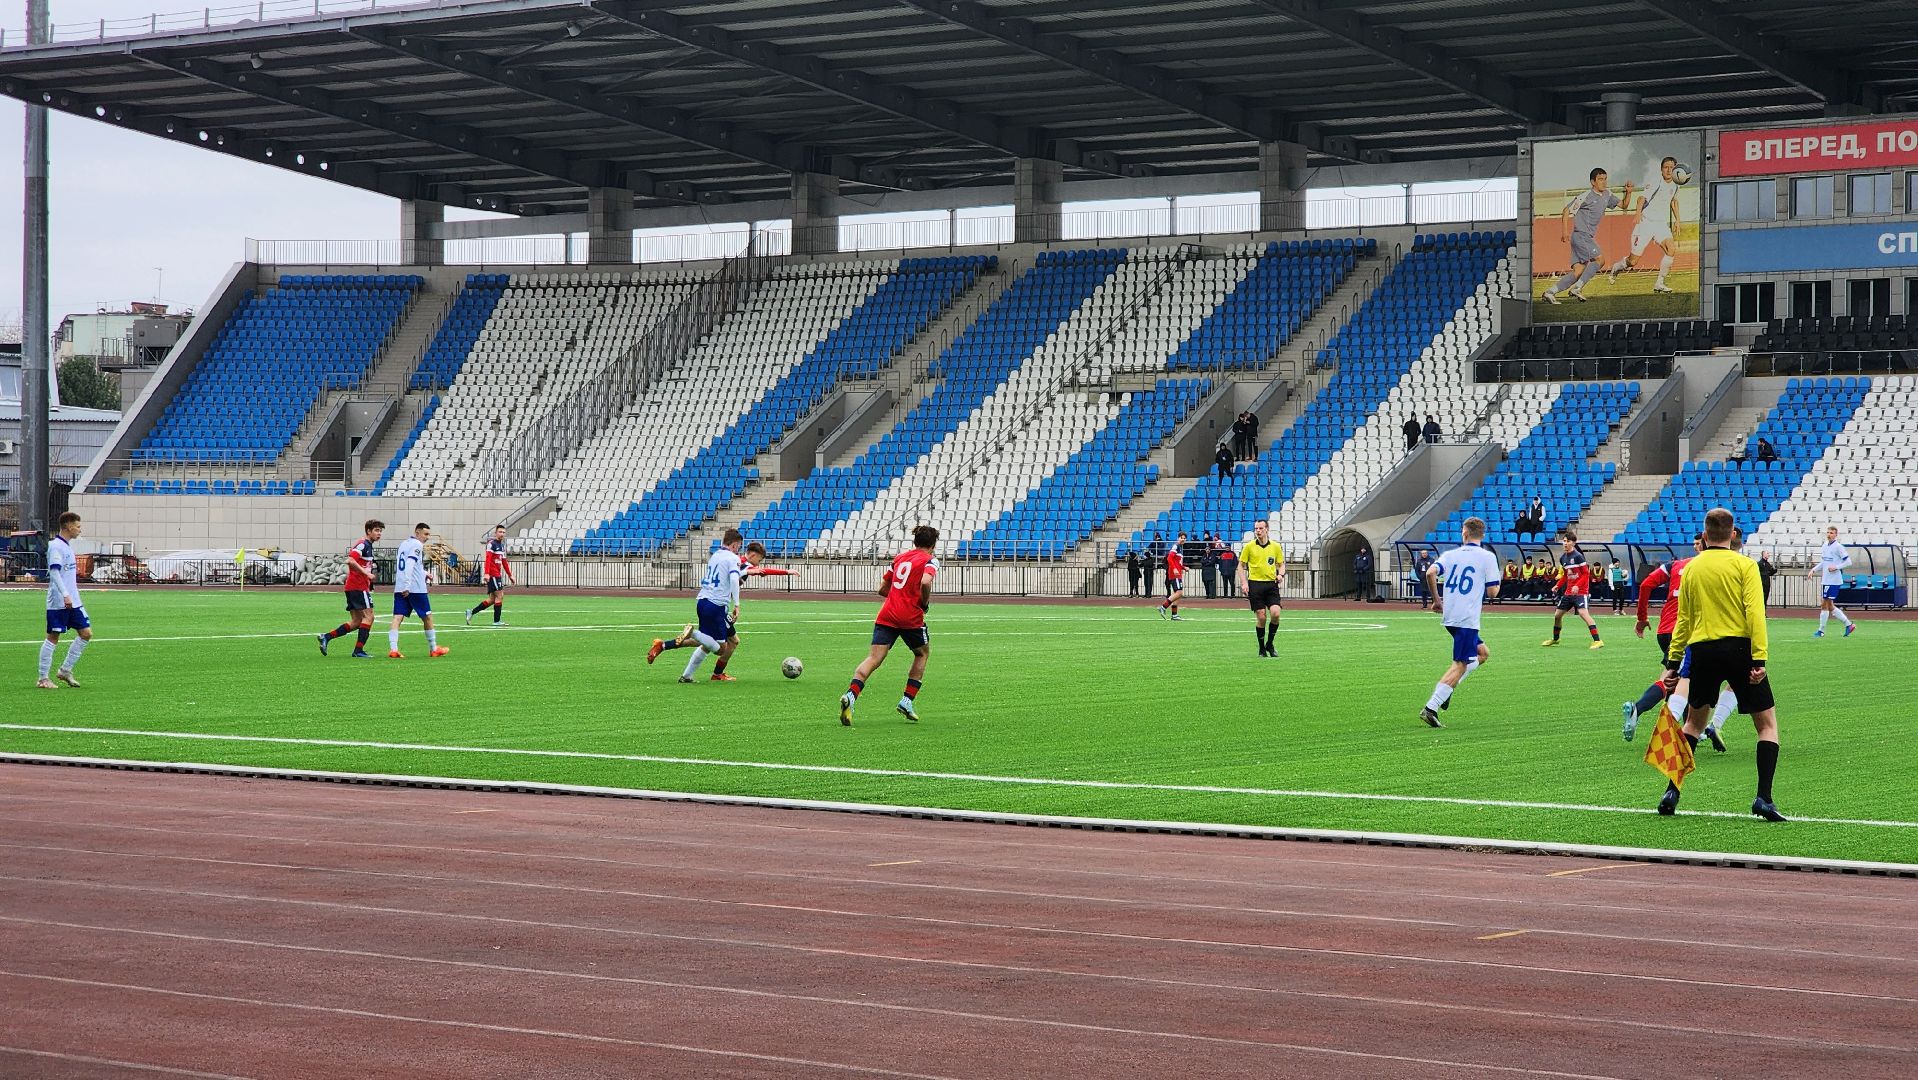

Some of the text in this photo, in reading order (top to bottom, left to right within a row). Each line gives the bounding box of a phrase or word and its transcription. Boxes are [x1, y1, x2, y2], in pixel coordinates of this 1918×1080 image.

[1745, 130, 1918, 161] ВПЕРЕД, ПО
[1878, 232, 1918, 254] СП
[398, 551, 406, 571] 6
[893, 561, 912, 589] 9
[1445, 564, 1475, 595] 46
